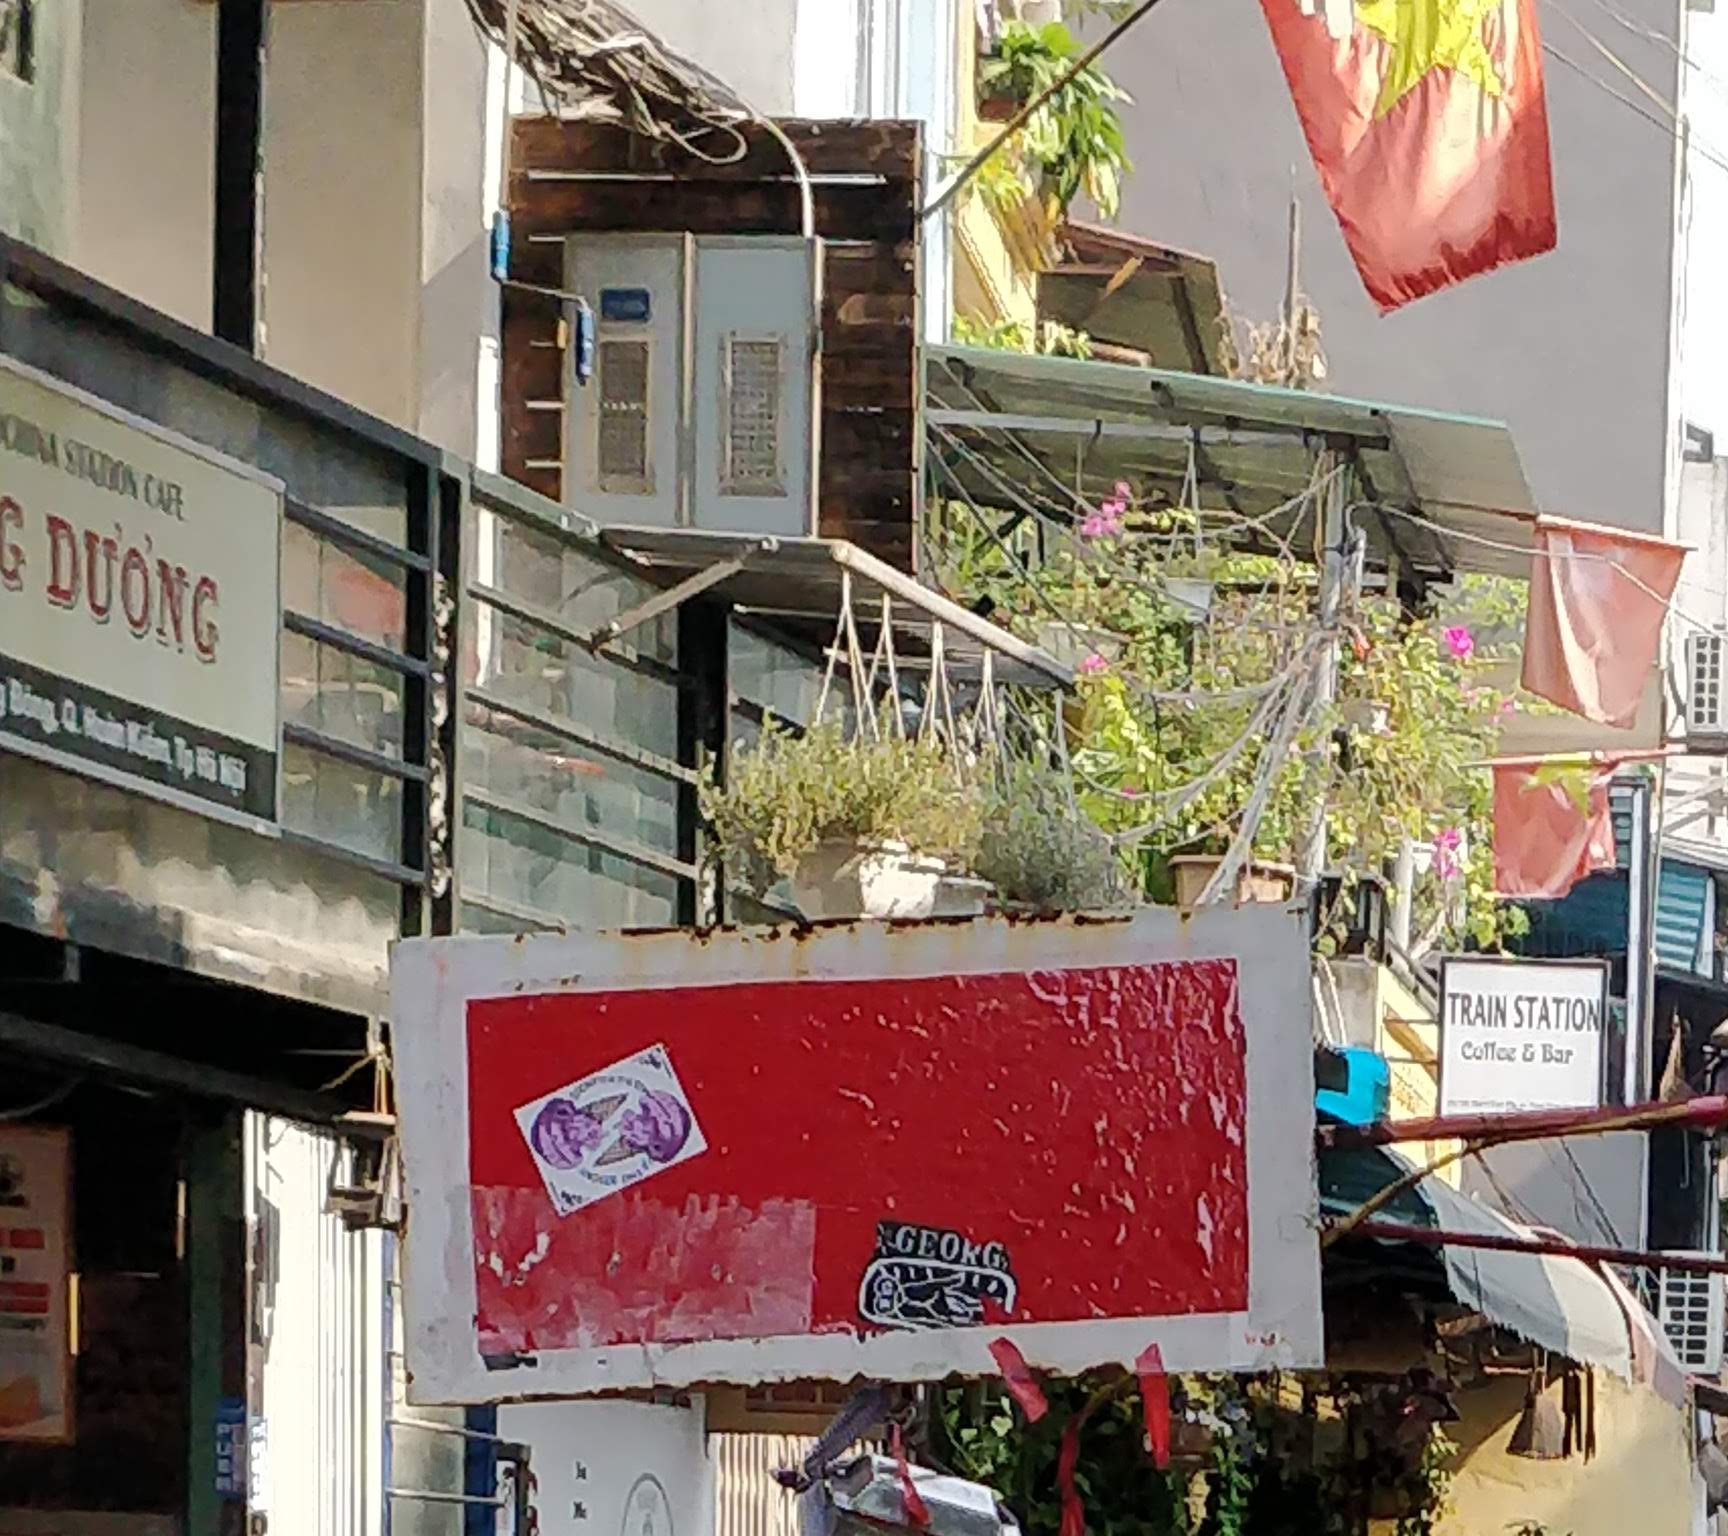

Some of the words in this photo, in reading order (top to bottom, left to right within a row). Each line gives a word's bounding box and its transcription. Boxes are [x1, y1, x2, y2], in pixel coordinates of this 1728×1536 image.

[46, 513, 218, 662] DƯƠNG
[1447, 992, 1507, 1028] TRAIN
[1513, 994, 1601, 1033] STATION
[1460, 1041, 1517, 1063] Coffee
[1521, 1043, 1536, 1062] &
[1541, 1043, 1574, 1065] Bar
